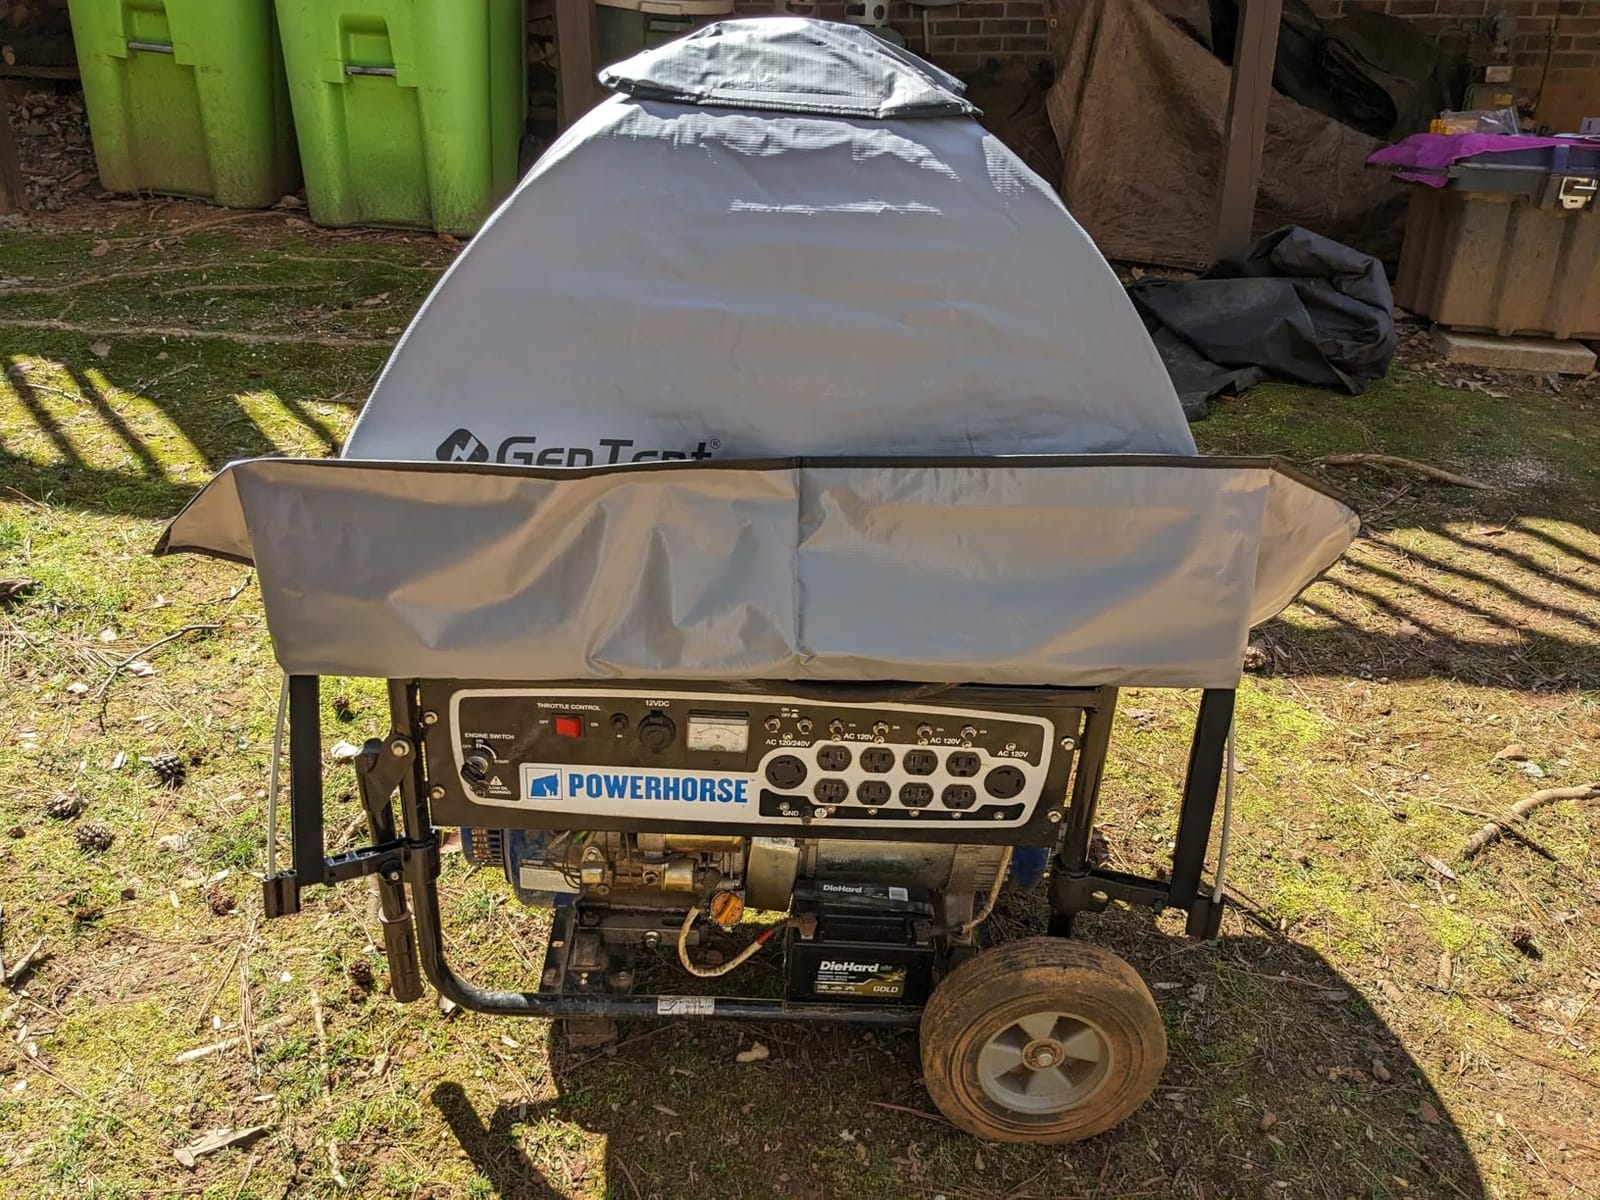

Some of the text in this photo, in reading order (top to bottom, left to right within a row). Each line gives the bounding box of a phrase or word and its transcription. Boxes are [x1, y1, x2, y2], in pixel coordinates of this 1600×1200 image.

[537, 702, 601, 713] THROTTLE CONTROL
[645, 699, 670, 707] 12VDC
[778, 740, 811, 748] 120/240V
[997, 750, 1029, 759] AC 120V
[568, 773, 749, 804] POWERHORSE
[823, 884, 862, 894] DieHard
[820, 960, 880, 973] DieHard
[873, 985, 899, 993] GOLD
